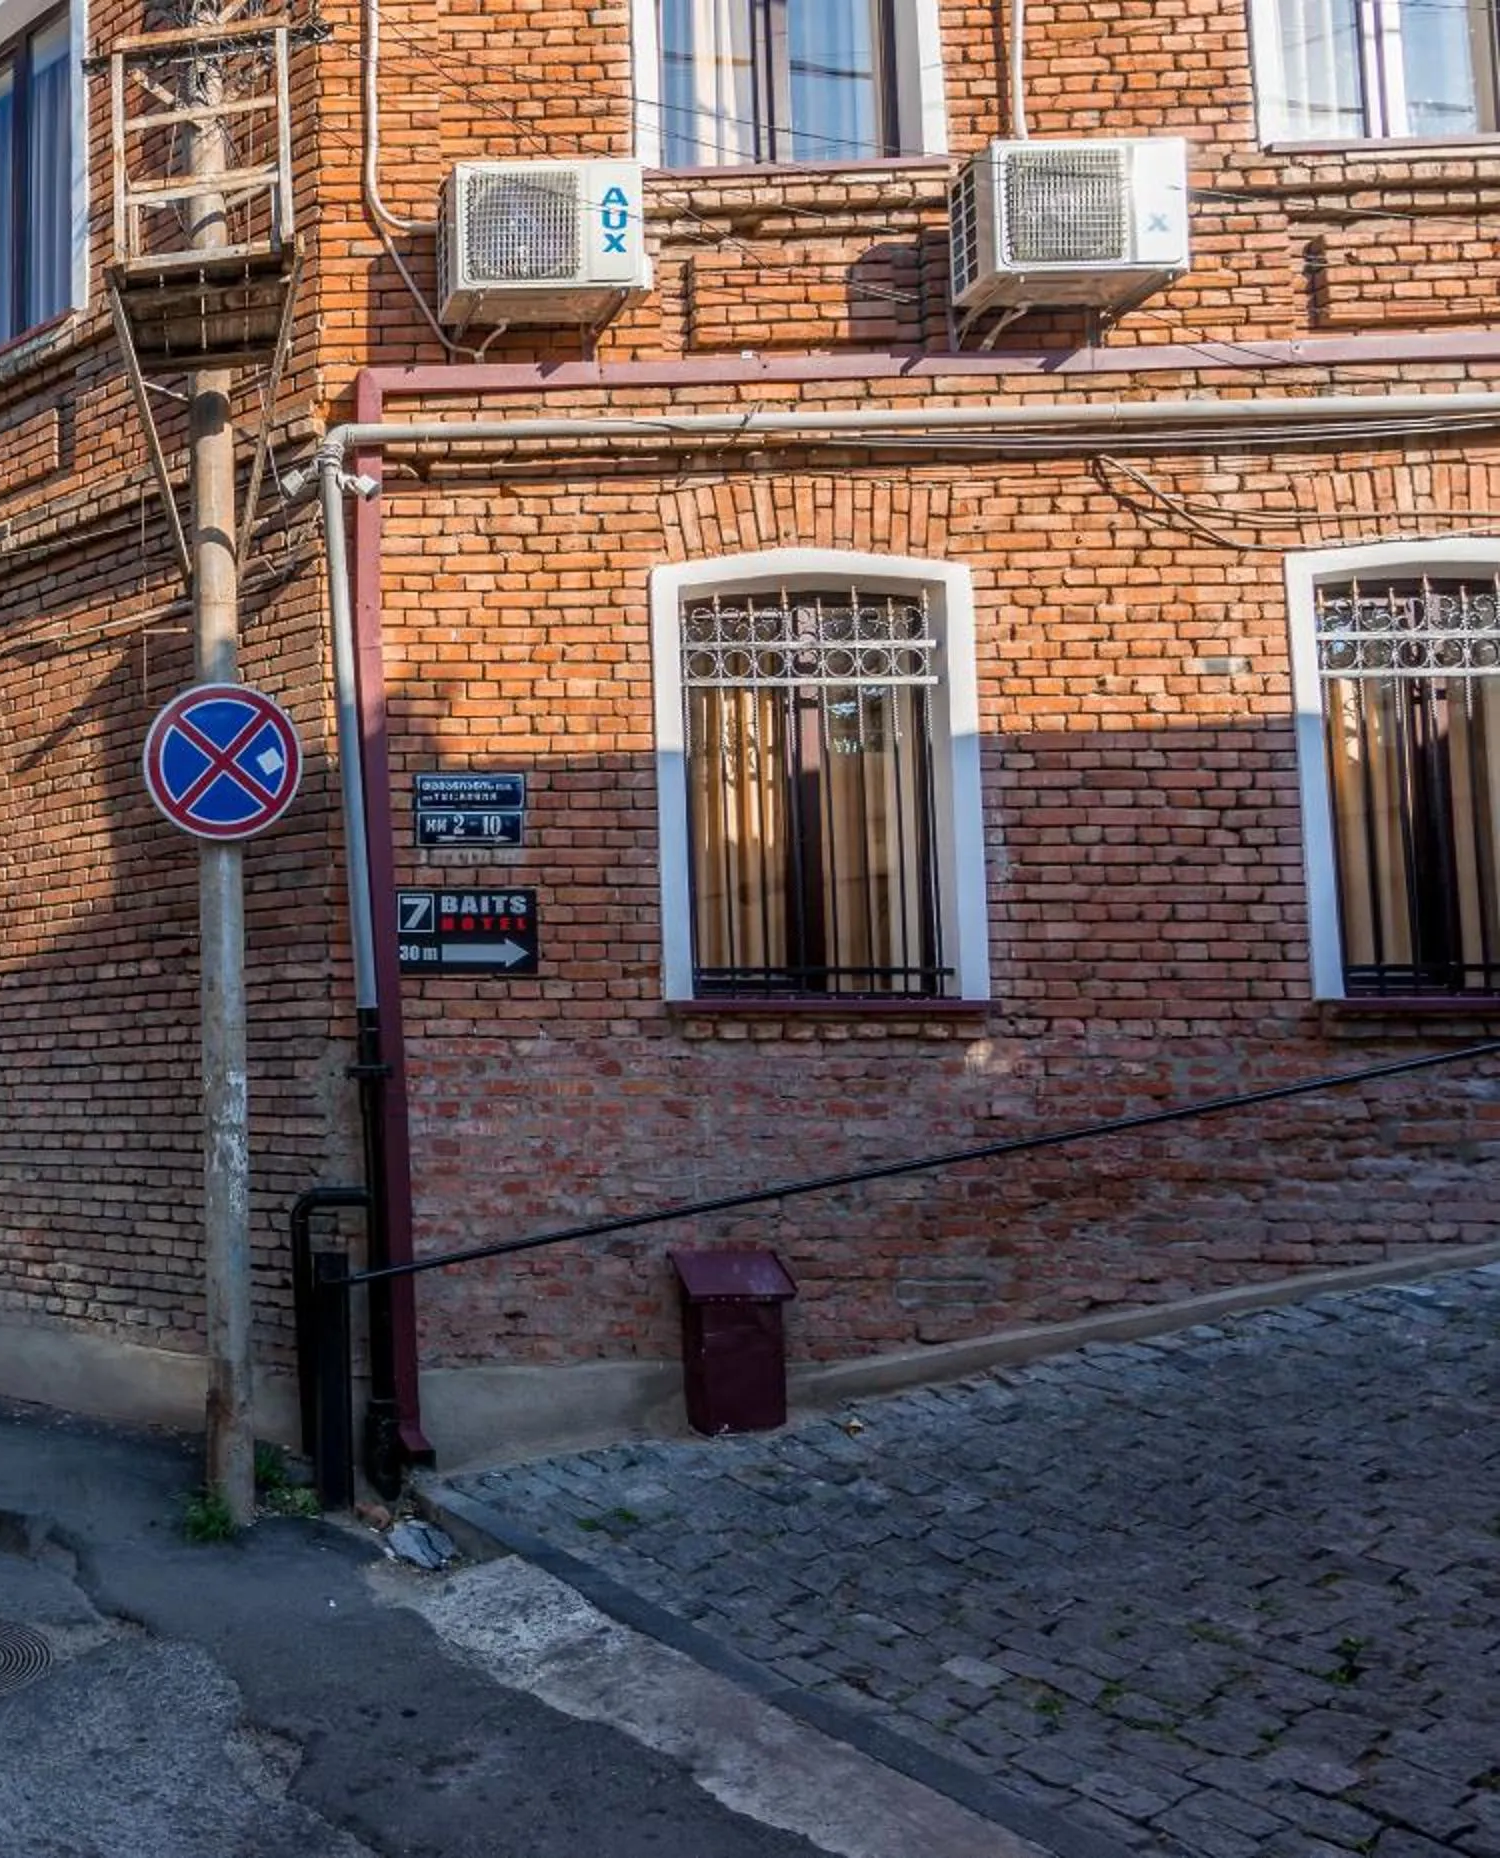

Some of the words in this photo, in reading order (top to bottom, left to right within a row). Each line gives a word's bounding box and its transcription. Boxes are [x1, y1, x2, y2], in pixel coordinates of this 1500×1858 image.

[602, 187, 628, 253] AUX
[453, 814, 465, 835] 2
[402, 897, 430, 929] 7
[441, 895, 527, 914] BAITS
[399, 944, 420, 961] 30
